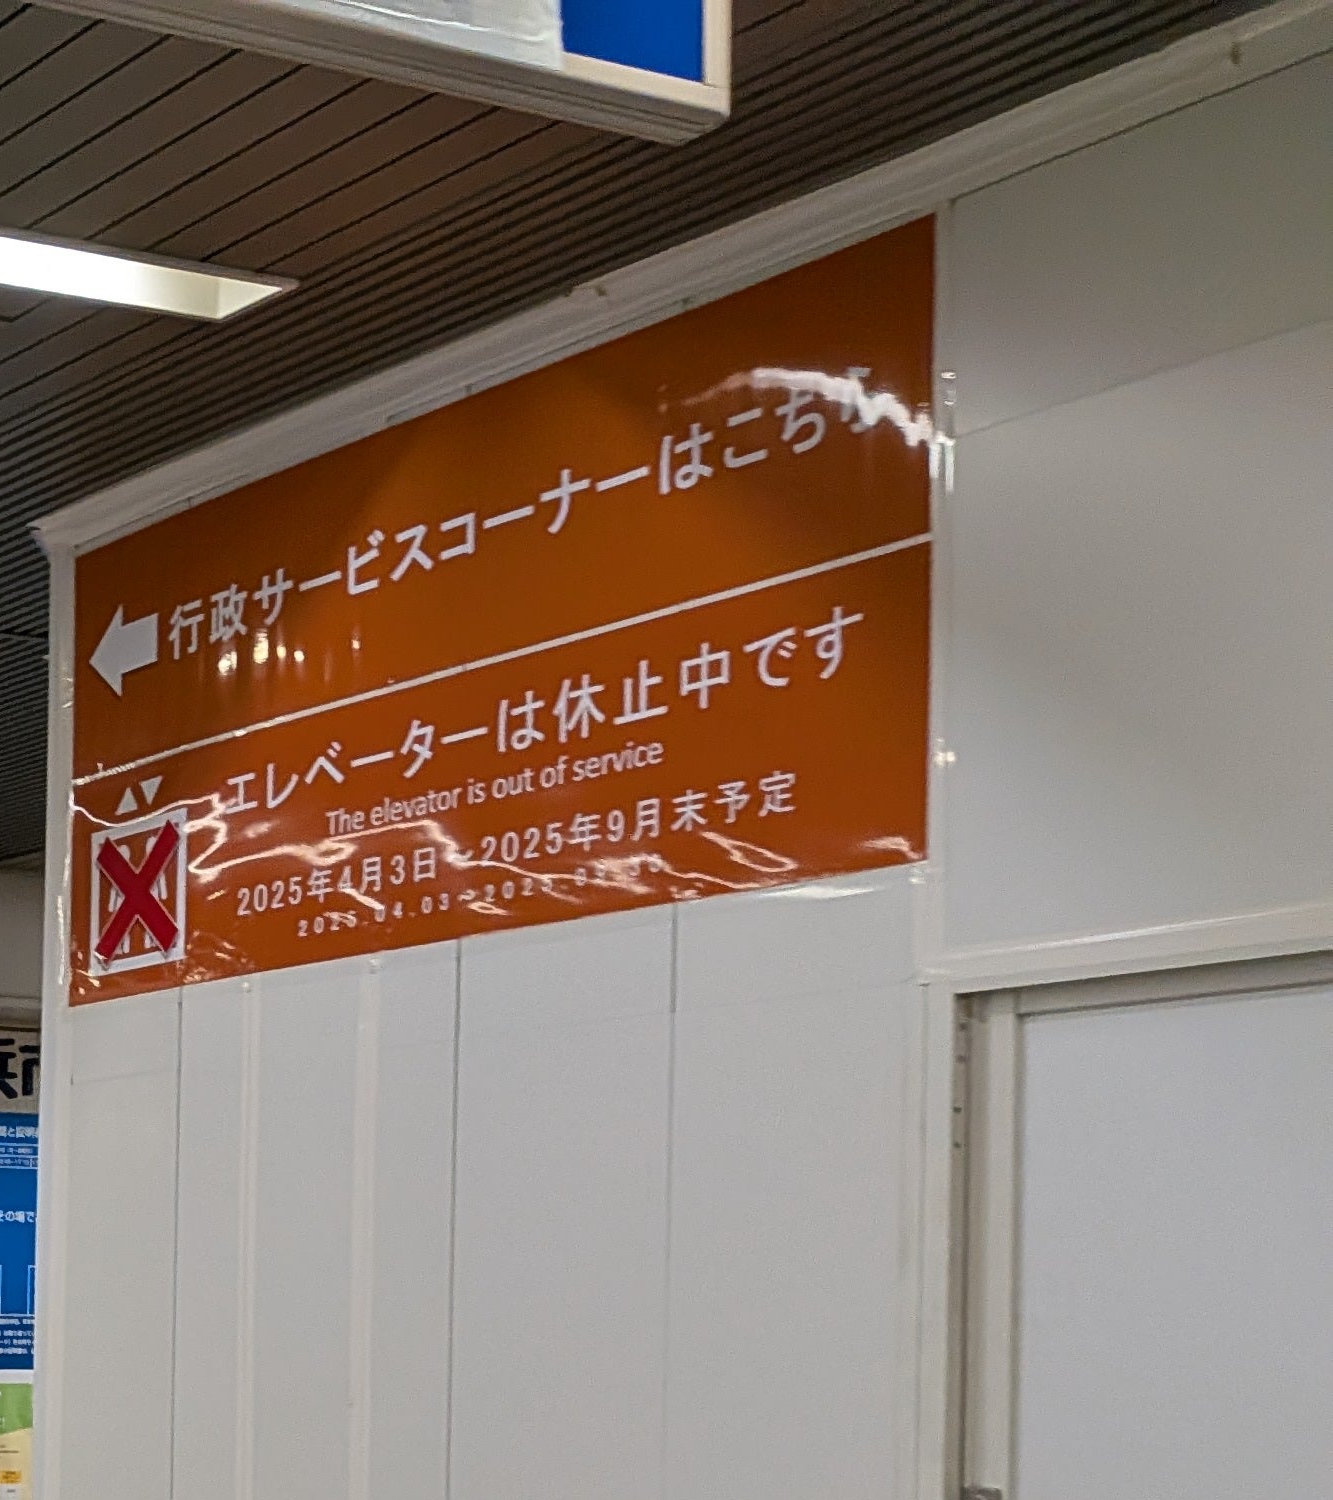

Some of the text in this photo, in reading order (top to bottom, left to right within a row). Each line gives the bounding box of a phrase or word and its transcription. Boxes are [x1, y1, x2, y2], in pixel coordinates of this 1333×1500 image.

[224, 606, 865, 816] エレベーターは休止中です
[326, 740, 665, 837] The elevator is out of service
